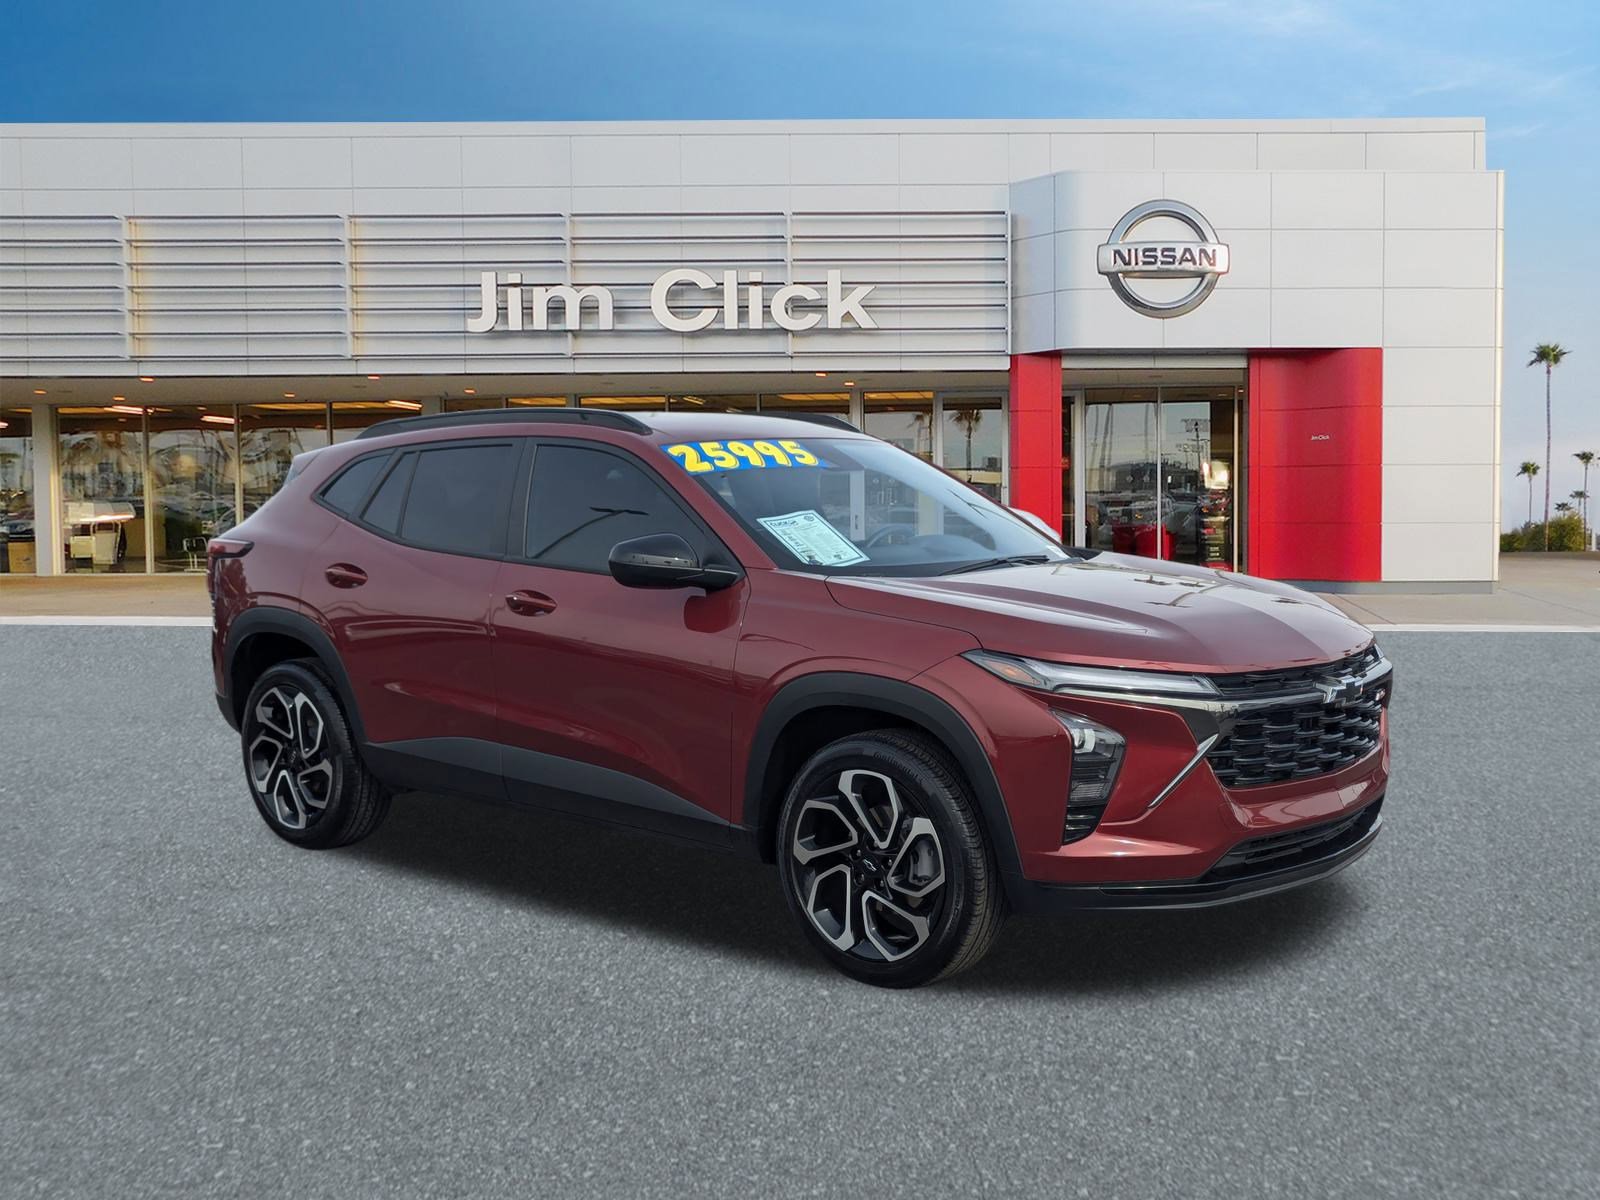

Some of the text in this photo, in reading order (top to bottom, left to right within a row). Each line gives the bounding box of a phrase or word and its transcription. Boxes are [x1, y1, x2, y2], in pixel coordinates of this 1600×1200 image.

[1112, 247, 1217, 267] NISSAN
[467, 268, 879, 333] Jim Click
[667, 440, 819, 473] 25995
